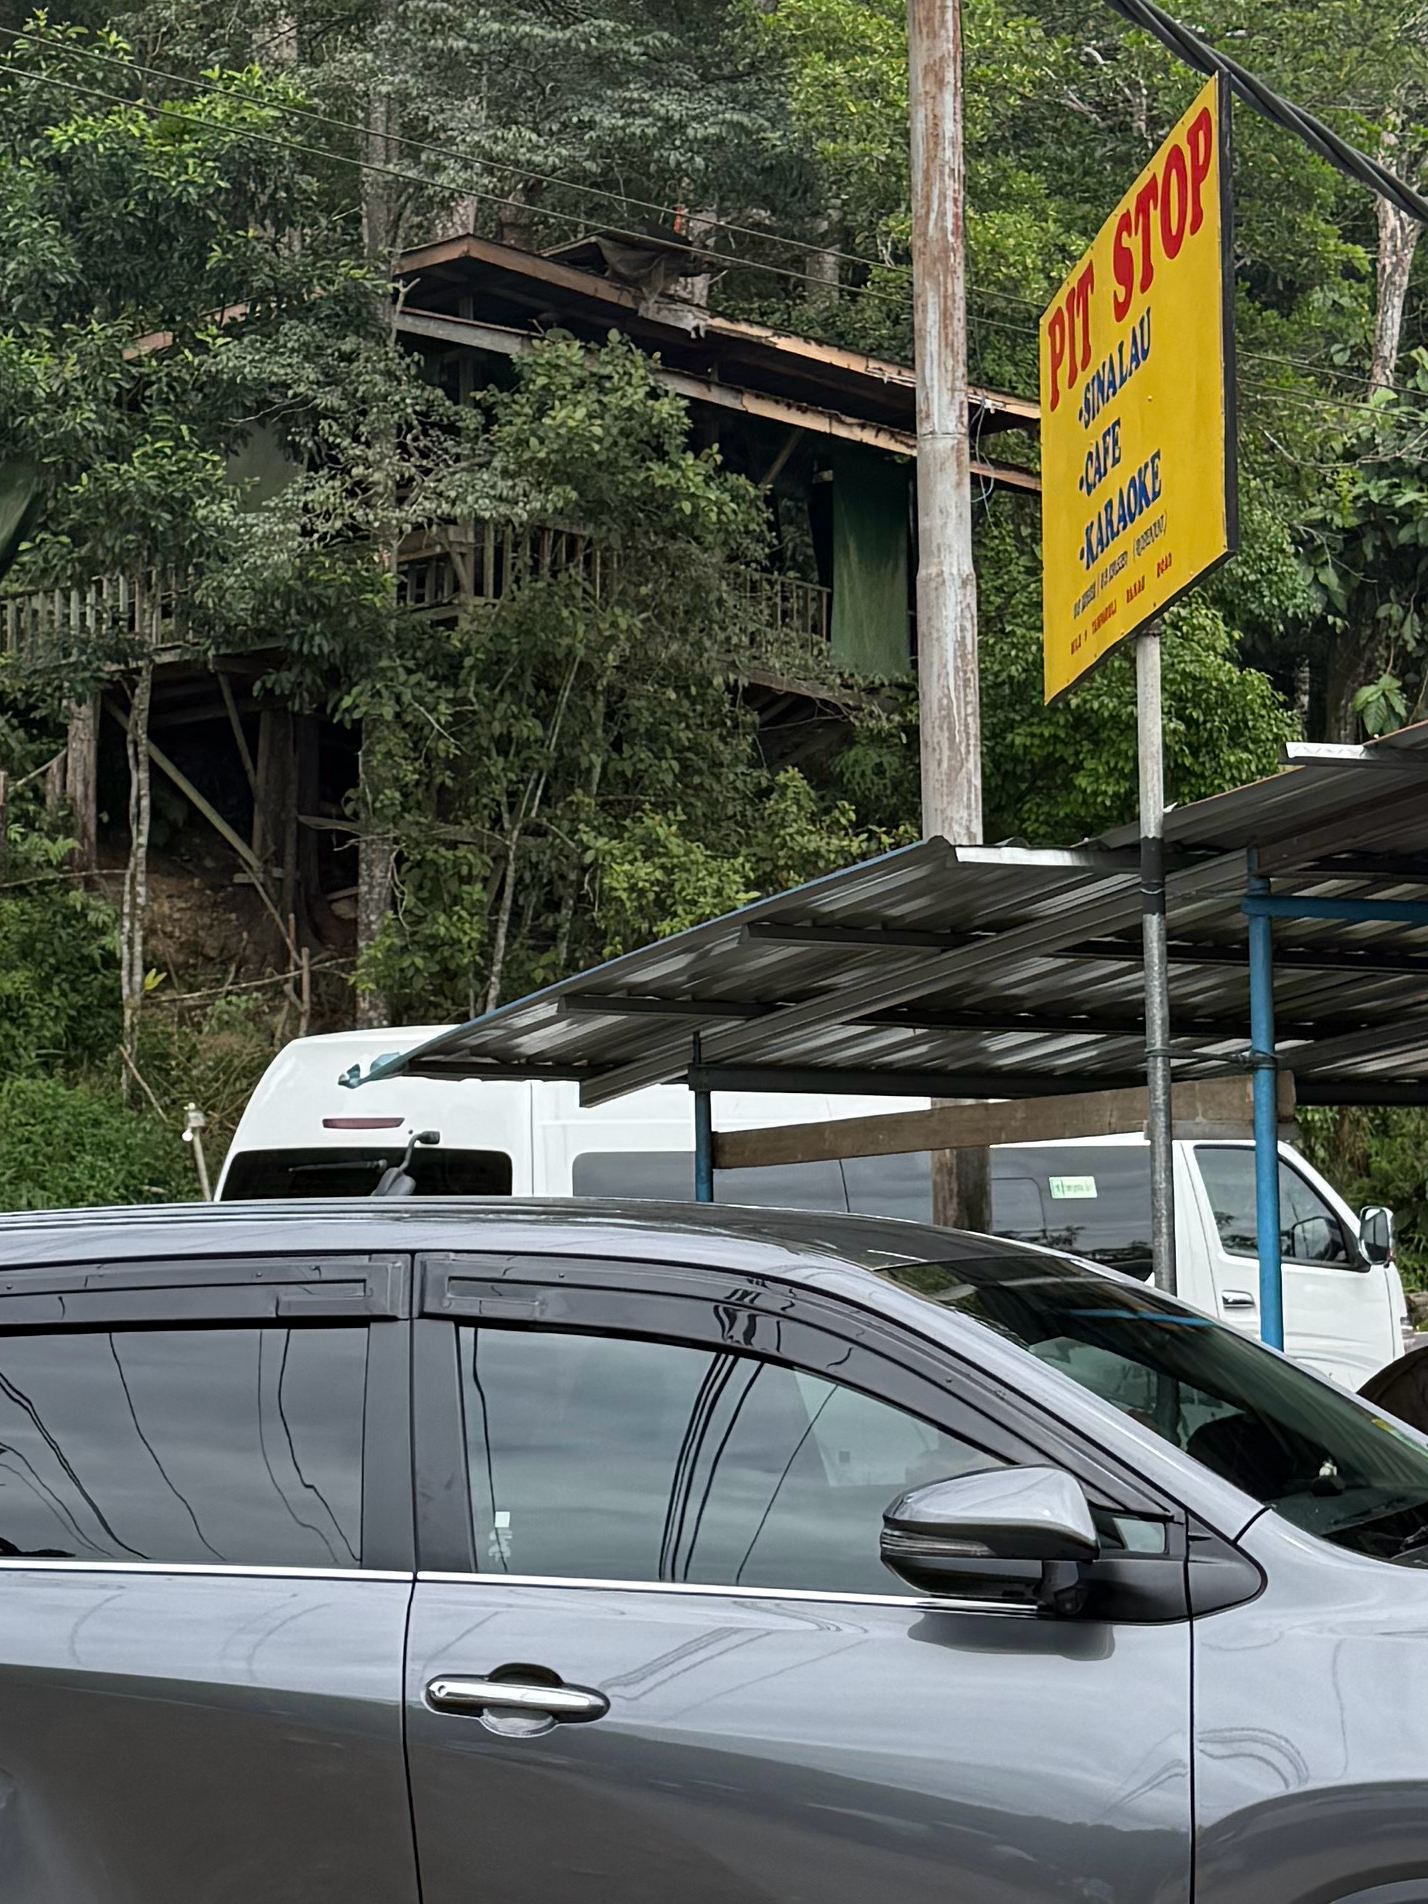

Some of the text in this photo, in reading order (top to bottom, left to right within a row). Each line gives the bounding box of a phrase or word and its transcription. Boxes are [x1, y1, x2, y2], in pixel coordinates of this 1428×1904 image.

[1047, 106, 1213, 413] PIT STOP
[1082, 306, 1152, 430] SINALAU
[1083, 416, 1123, 496] CAFE
[1084, 448, 1163, 571] KARAOKE
